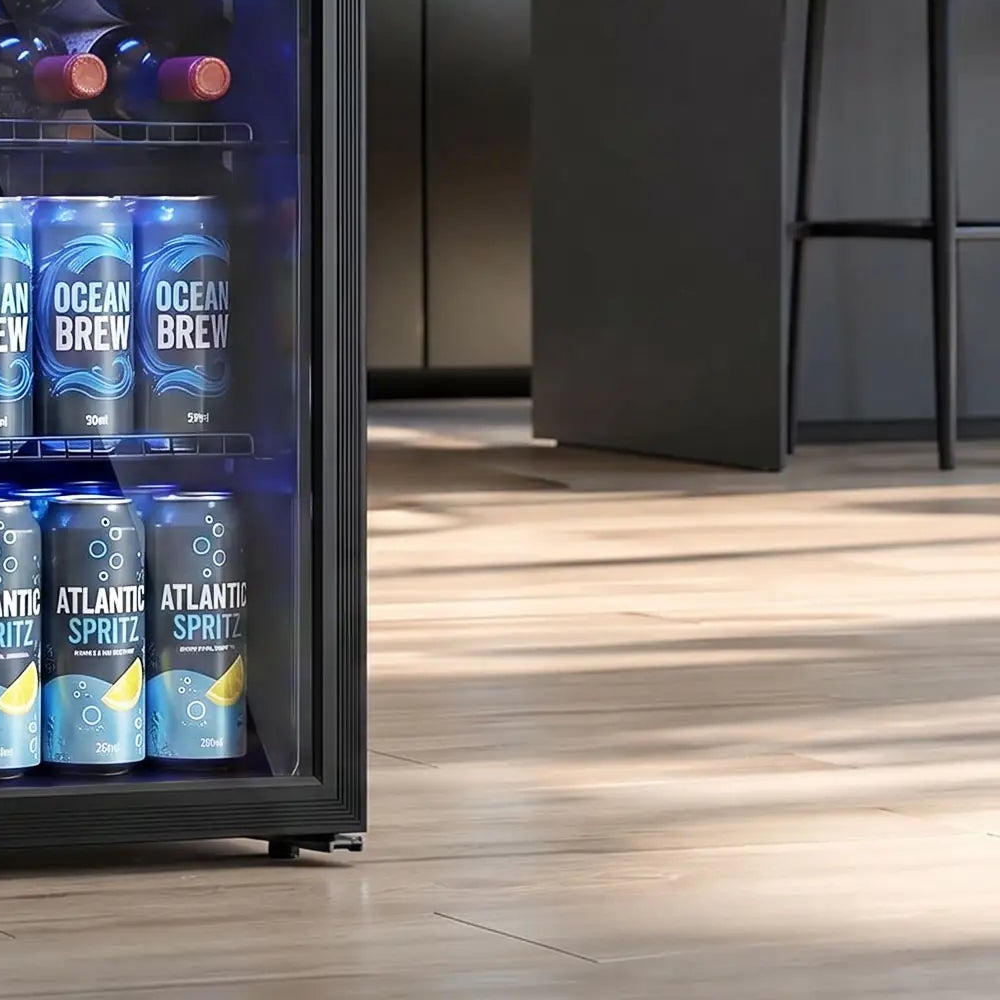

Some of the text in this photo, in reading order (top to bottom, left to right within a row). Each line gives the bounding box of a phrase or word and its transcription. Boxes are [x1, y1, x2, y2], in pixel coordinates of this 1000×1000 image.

[54, 281, 130, 314] OCEAN
[156, 280, 229, 313] OCEAN
[55, 315, 130, 351] BREW
[157, 314, 229, 350] BREW
[56, 585, 145, 615] ATLANTIC
[161, 582, 248, 611] ATLANTIC
[68, 616, 139, 645] SPRITZ
[173, 613, 242, 642] SPRITZ
